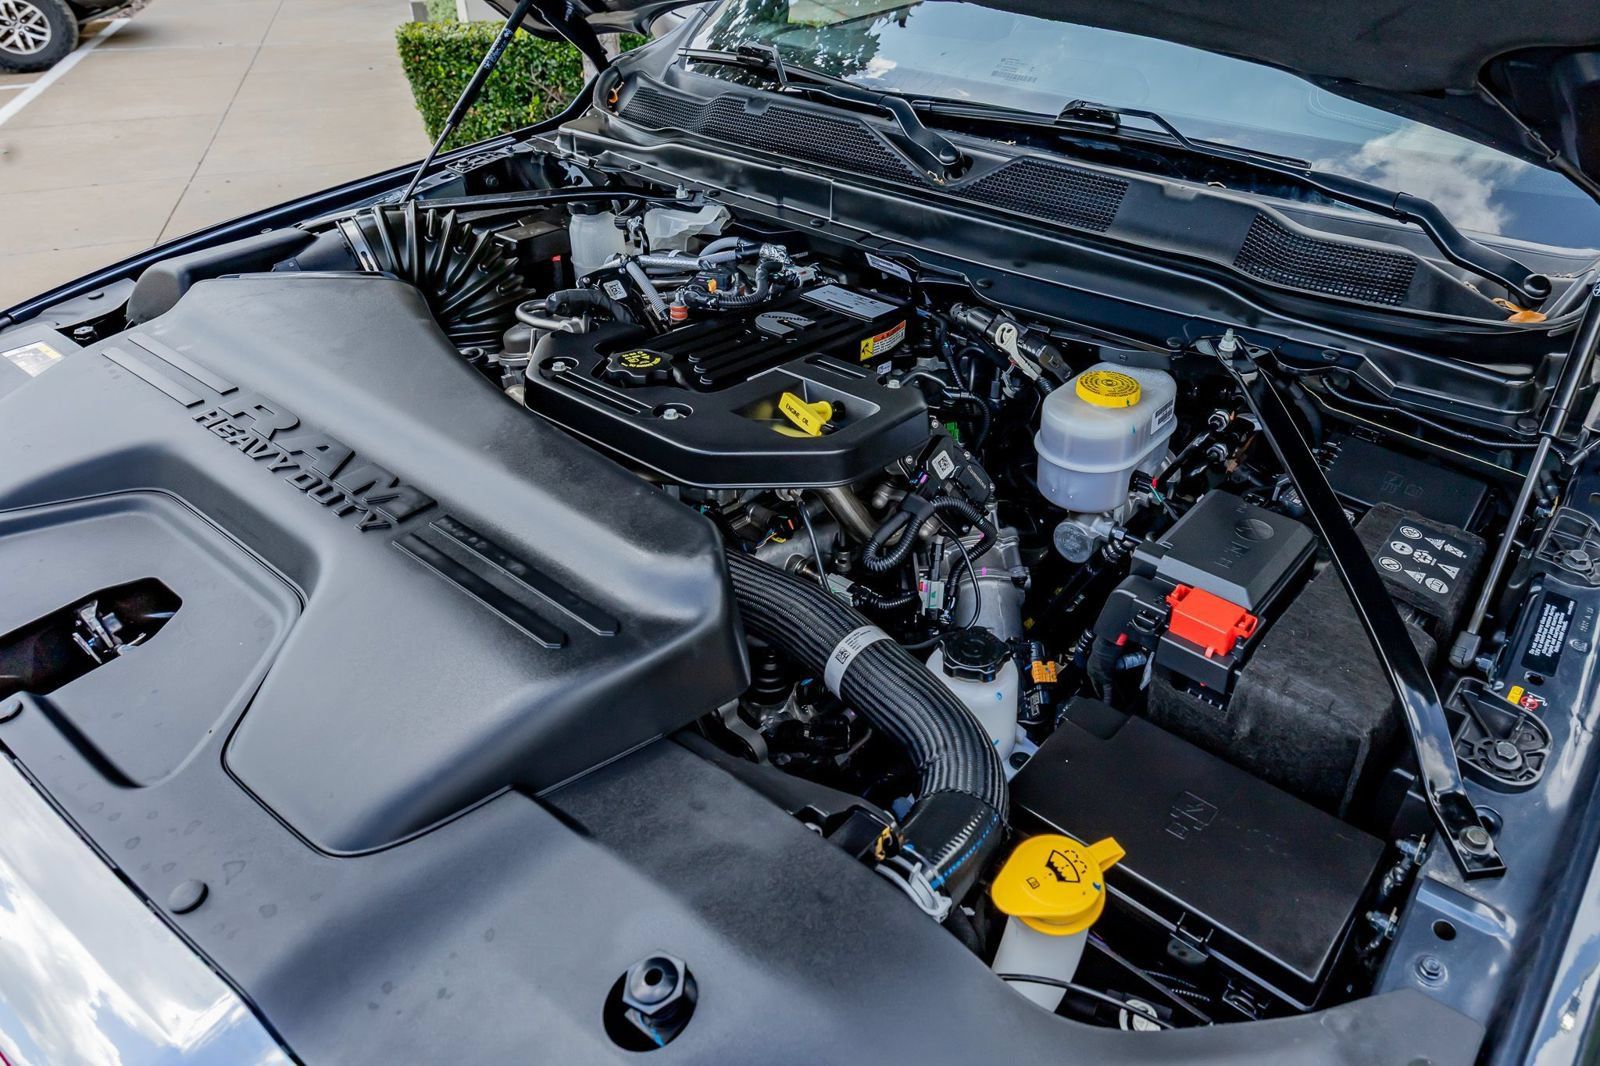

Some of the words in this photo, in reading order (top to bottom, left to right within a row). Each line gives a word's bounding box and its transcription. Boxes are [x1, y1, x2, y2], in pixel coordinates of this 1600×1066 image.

[192, 410, 300, 472] HEAVY
[284, 468, 392, 532] DUTY
[218, 394, 438, 524] RAM
